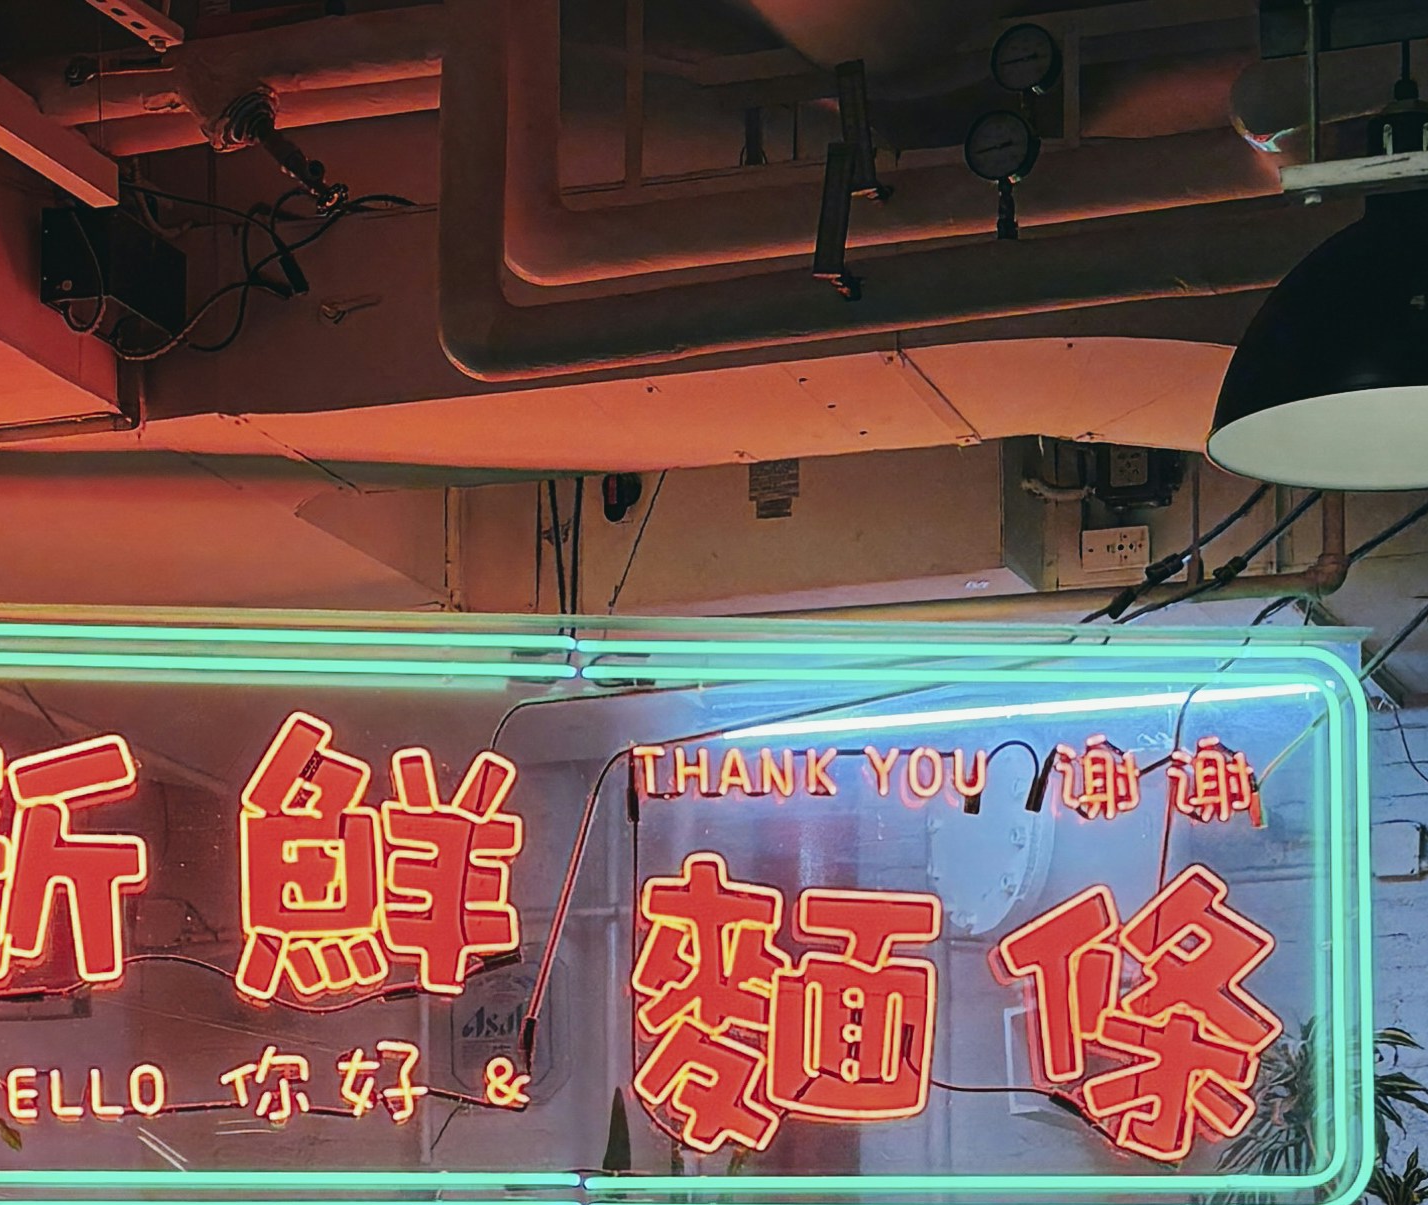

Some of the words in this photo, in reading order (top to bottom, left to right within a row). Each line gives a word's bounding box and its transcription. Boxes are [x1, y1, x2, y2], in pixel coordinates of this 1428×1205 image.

[632, 745, 840, 798] THANK
[865, 746, 988, 799] YOU
[221, 1041, 428, 1122] 你好
[484, 1056, 530, 1107] &
